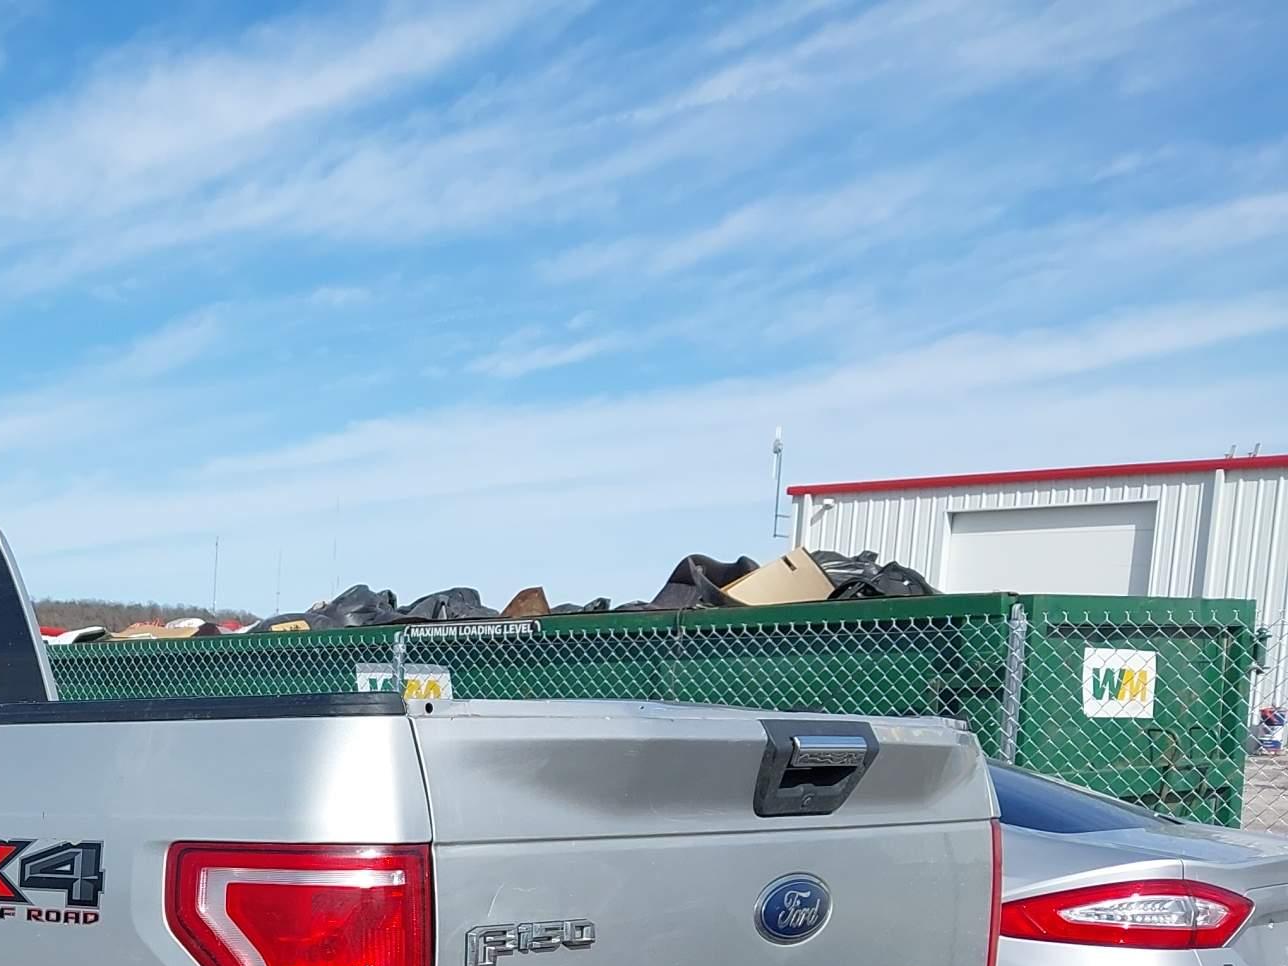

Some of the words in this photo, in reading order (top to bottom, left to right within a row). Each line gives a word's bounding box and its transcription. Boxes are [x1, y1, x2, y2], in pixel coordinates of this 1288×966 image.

[410, 625, 457, 638] MAXIMUM
[458, 624, 503, 637] LOADING
[503, 623, 534, 635] LEVEL
[1091, 667, 1149, 702] WM
[26, 908, 100, 926] ROAD
[777, 889, 821, 930] Ford
